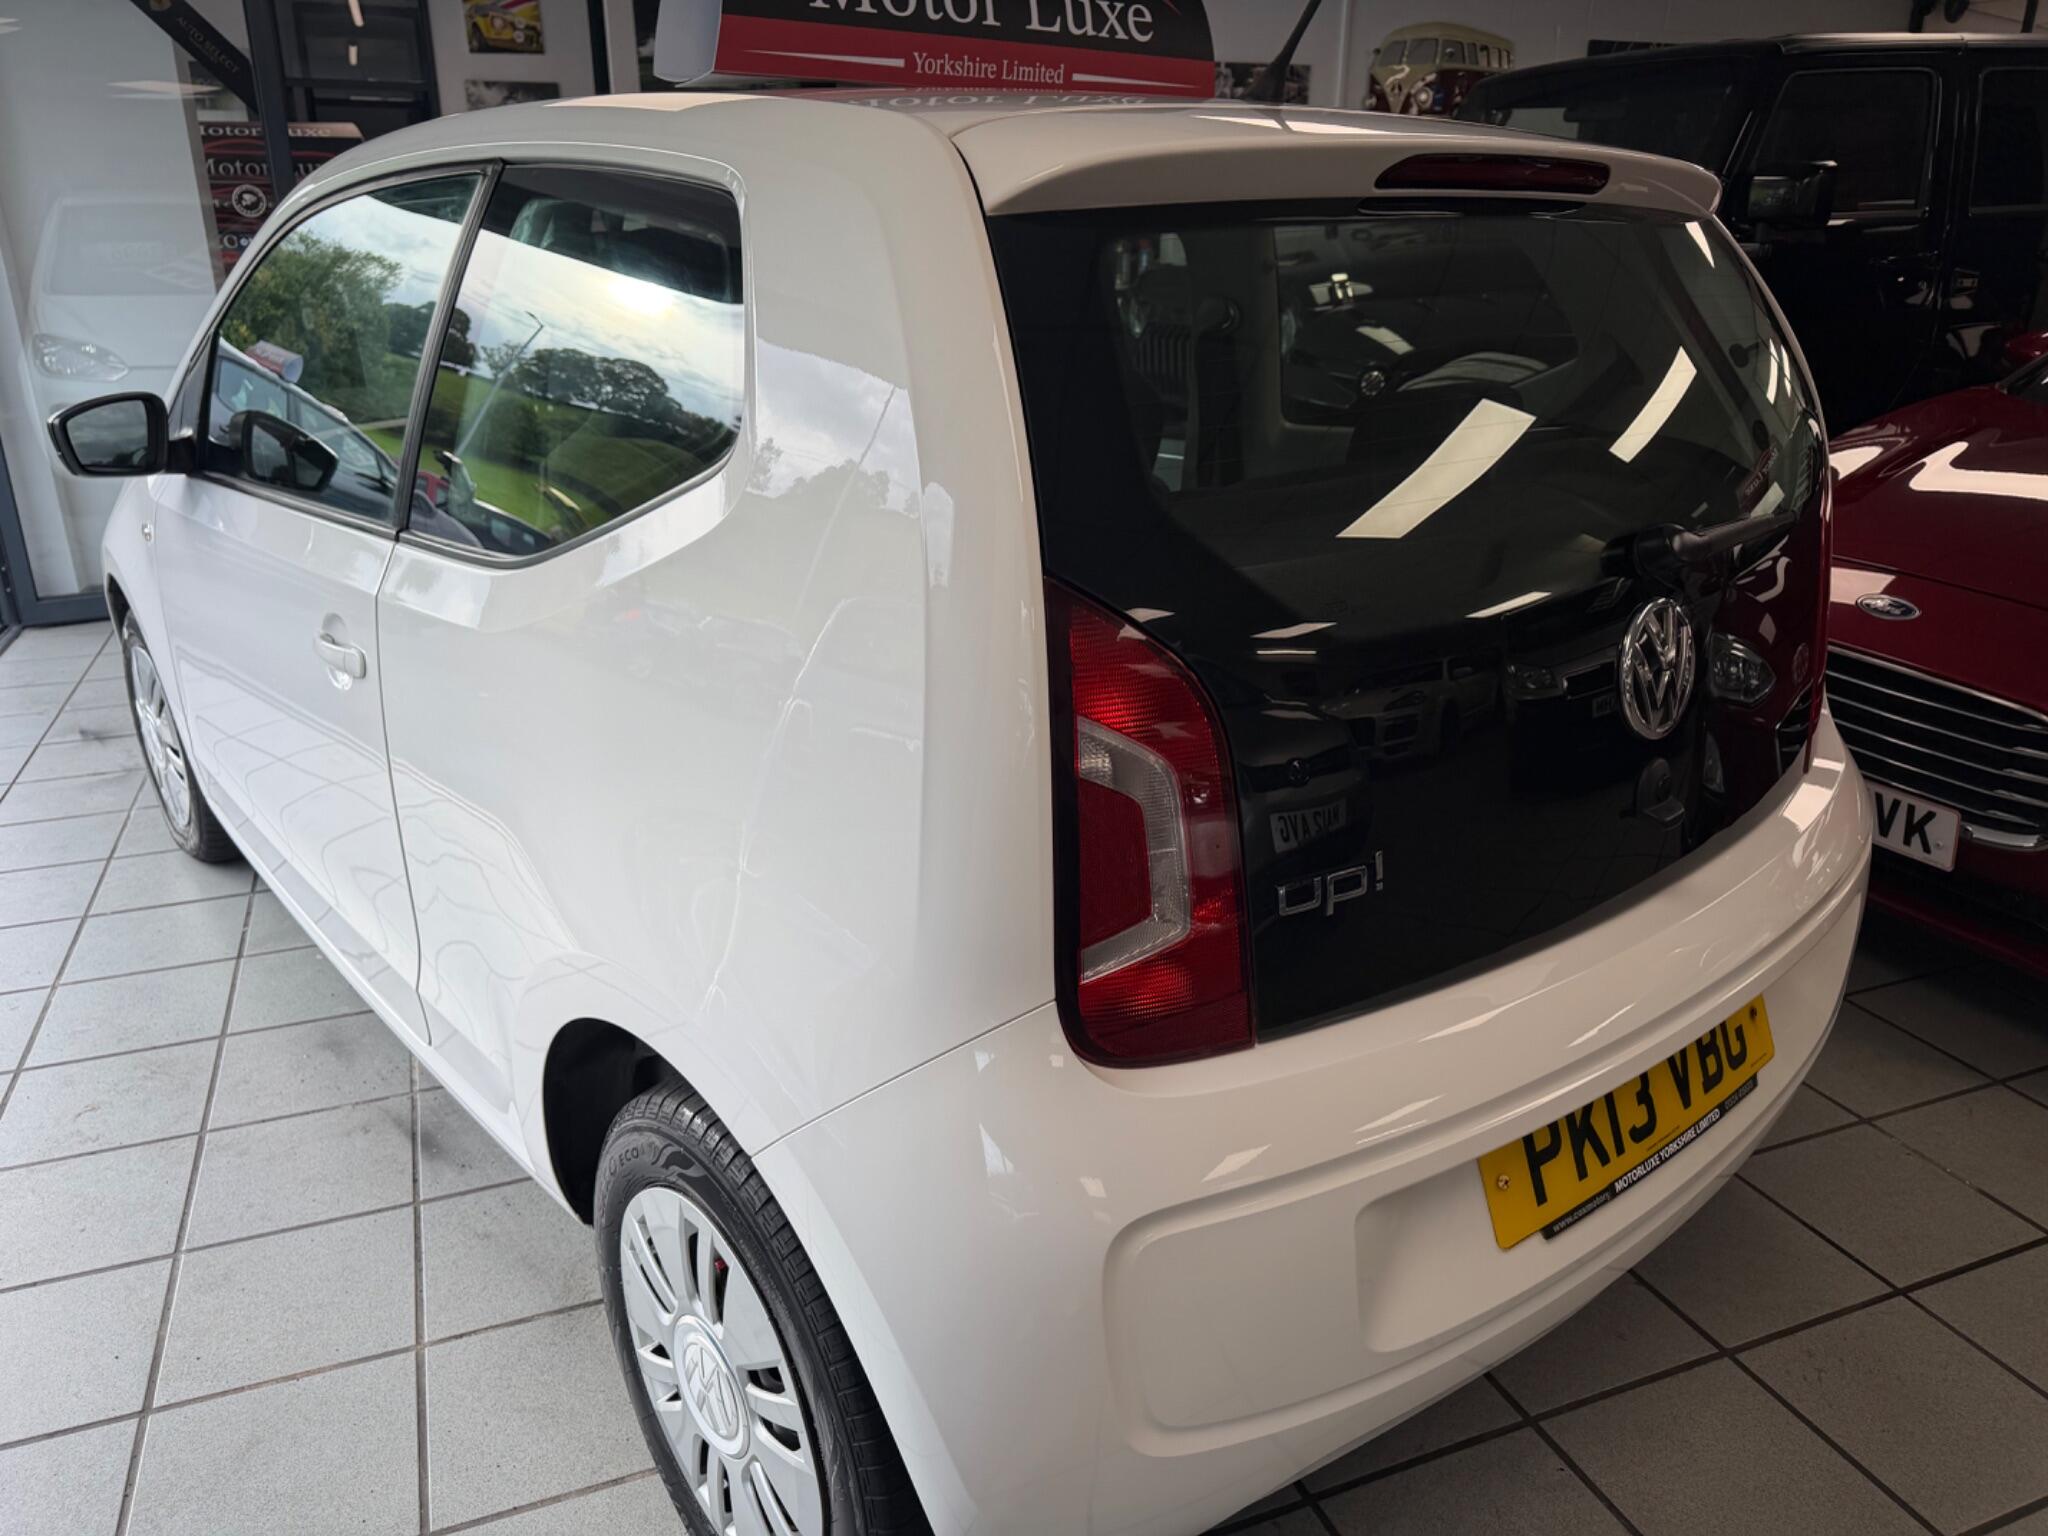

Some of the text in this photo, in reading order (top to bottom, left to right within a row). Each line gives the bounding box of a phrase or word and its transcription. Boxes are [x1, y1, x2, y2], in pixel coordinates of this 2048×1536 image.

[1025, 0, 1154, 43] Luxe
[912, 52, 1065, 85] Yorkshire Limited
[200, 125, 332, 138] otor uxe
[1875, 791, 1937, 855] VK
[1278, 849, 1384, 918] up!
[1523, 1019, 1748, 1207] PK13 VBG
[618, 1146, 640, 1168] ECO
[1614, 1153, 1661, 1194] MOTORLUXE
[1659, 1126, 1697, 1161] YORKSHIRE
[1696, 1107, 1721, 1135] LIMITED
